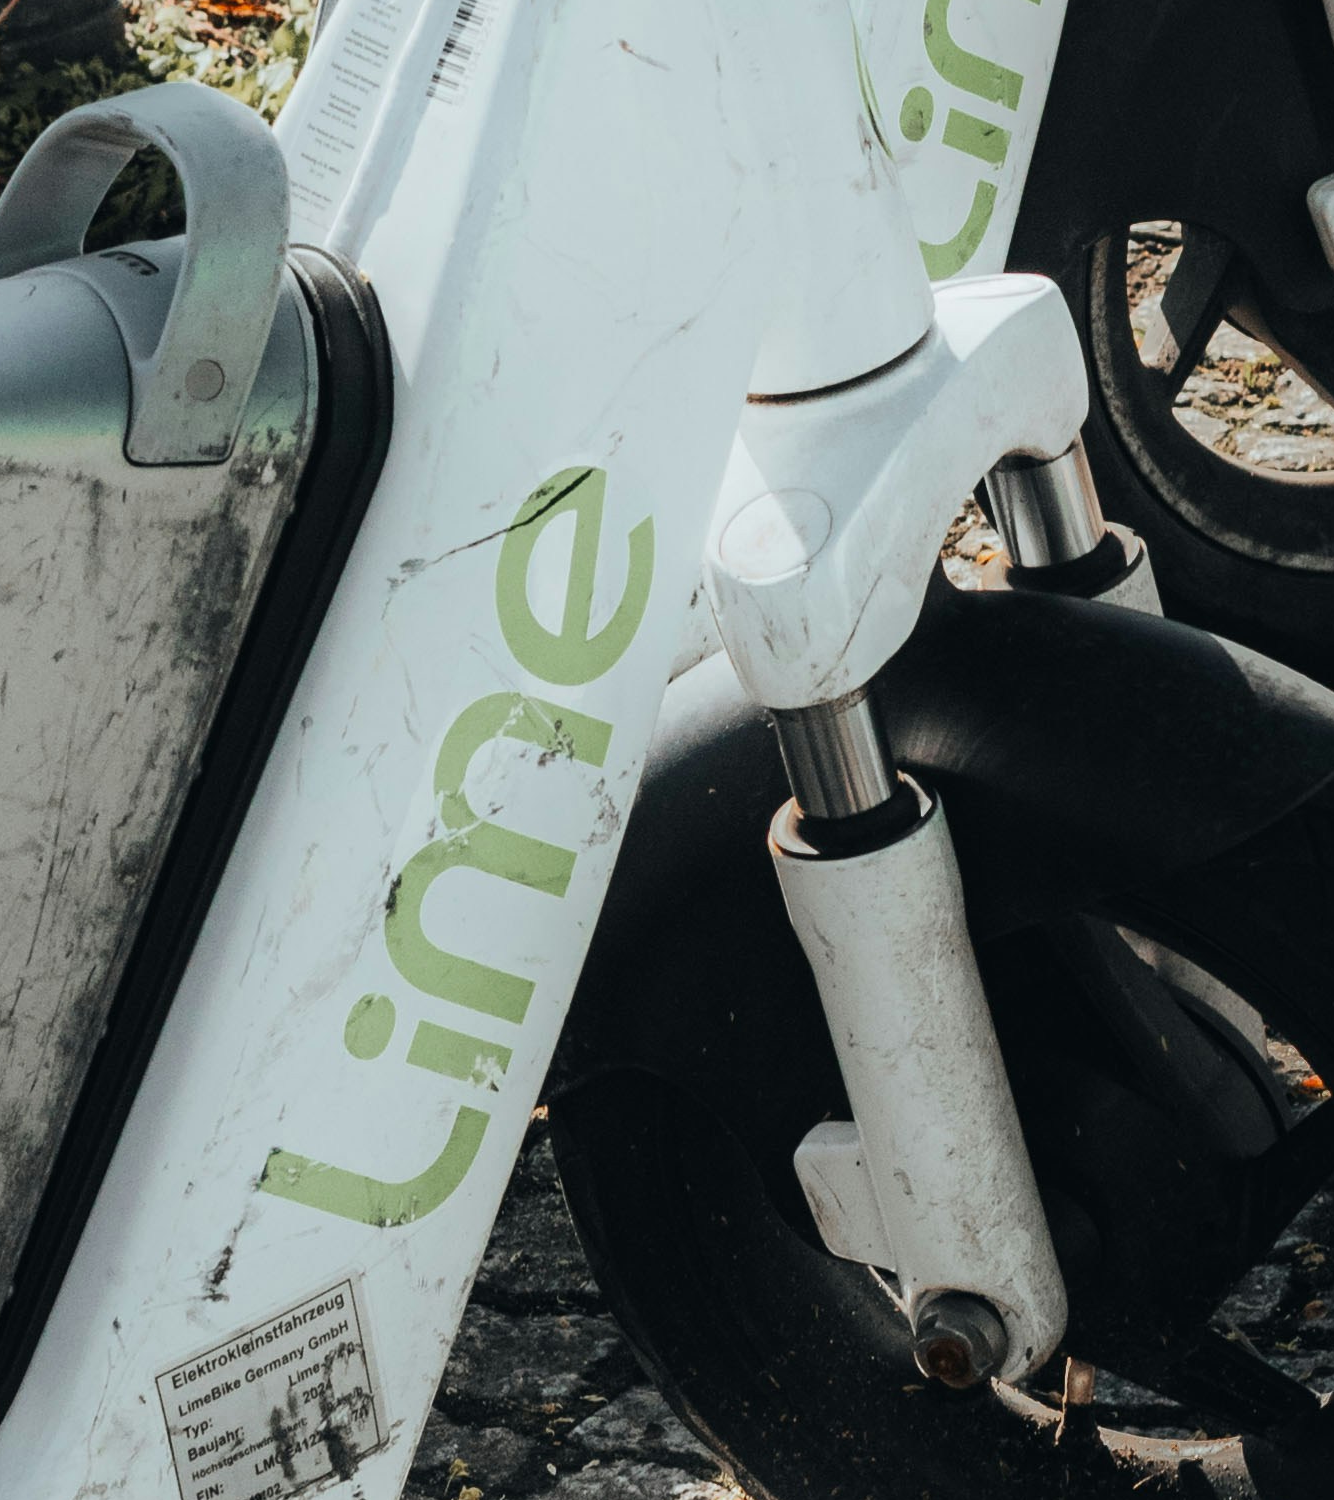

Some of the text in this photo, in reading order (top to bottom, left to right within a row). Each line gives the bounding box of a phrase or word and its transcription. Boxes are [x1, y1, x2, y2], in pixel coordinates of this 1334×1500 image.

[260, 465, 655, 1229] Lime
[171, 1293, 345, 1389] Elektrokleinstfahrzeug
[178, 1379, 241, 1417] LimeBike
[244, 1346, 305, 1383] Germany
[308, 1320, 349, 1350] GmbH
[183, 1417, 214, 1439] Typ:
[187, 1426, 245, 1462] Baujahr:
